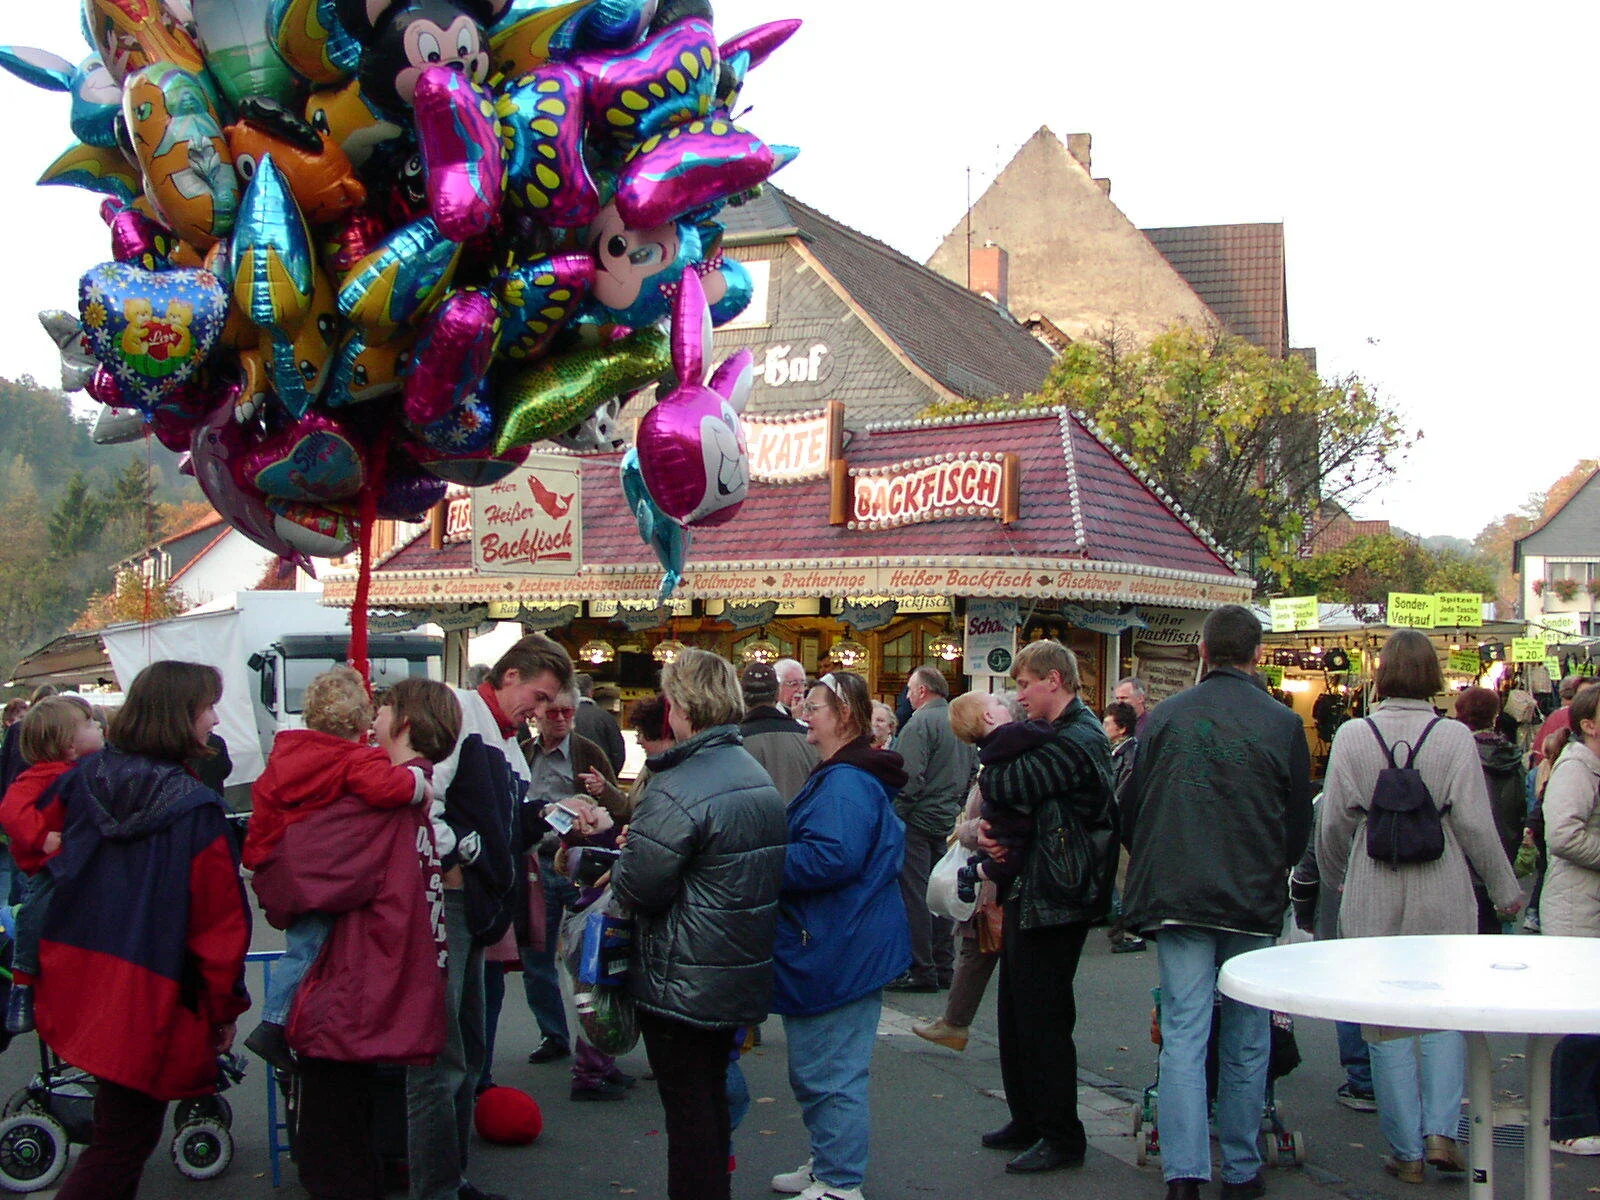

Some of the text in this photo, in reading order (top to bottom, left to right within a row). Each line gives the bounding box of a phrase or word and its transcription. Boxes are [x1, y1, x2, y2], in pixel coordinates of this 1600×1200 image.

[491, 482, 517, 495] Hier
[855, 462, 1001, 520] BACKFISCH
[448, 500, 472, 533] FIS
[484, 501, 534, 526] Heißer
[480, 519, 572, 565] Backfisch
[445, 579, 501, 594] Calamares
[518, 575, 661, 593] Leckere Fischspezialität
[782, 571, 866, 590] Bratheringe
[890, 569, 1032, 589] Heißer Backfisch
[400, 581, 429, 596] Lachs
[1394, 596, 1429, 611] Sonder-
[1082, 614, 1128, 628] Rollmops
[1391, 611, 1431, 626] Verkauf
